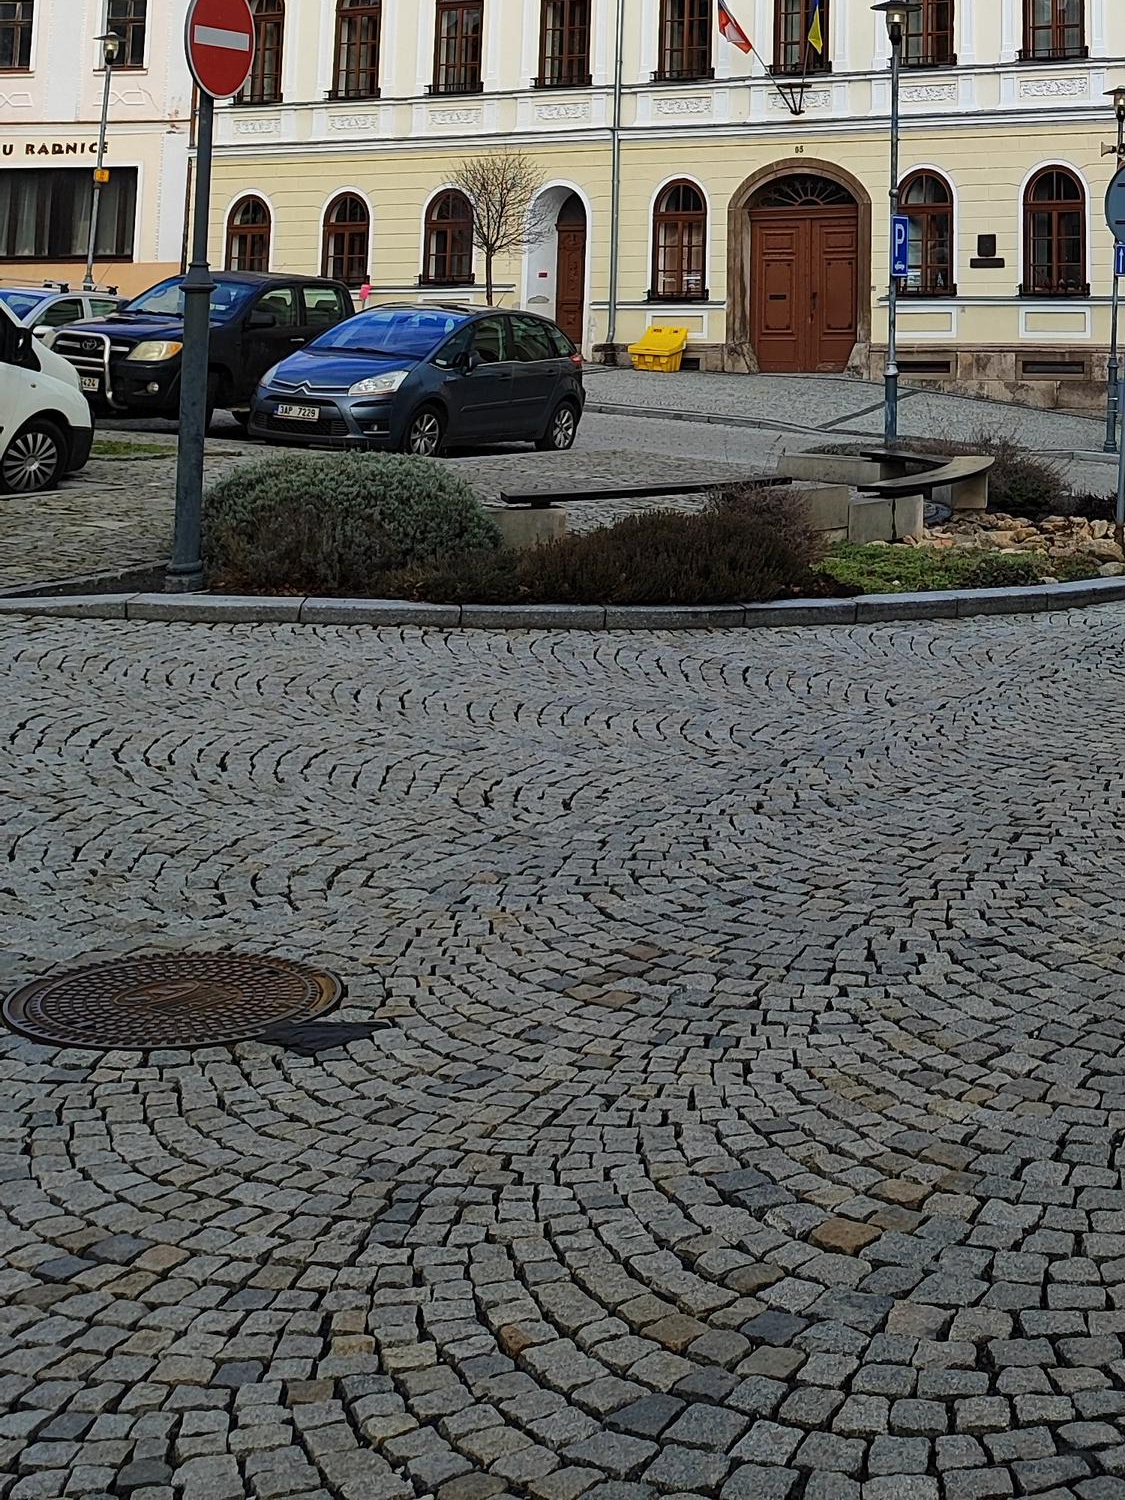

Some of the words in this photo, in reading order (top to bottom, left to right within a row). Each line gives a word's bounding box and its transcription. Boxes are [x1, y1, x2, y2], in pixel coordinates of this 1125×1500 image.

[2, 144, 14, 156] U
[25, 141, 109, 155] RADNICE
[894, 223, 905, 258] P
[280, 405, 293, 414] 3AP
